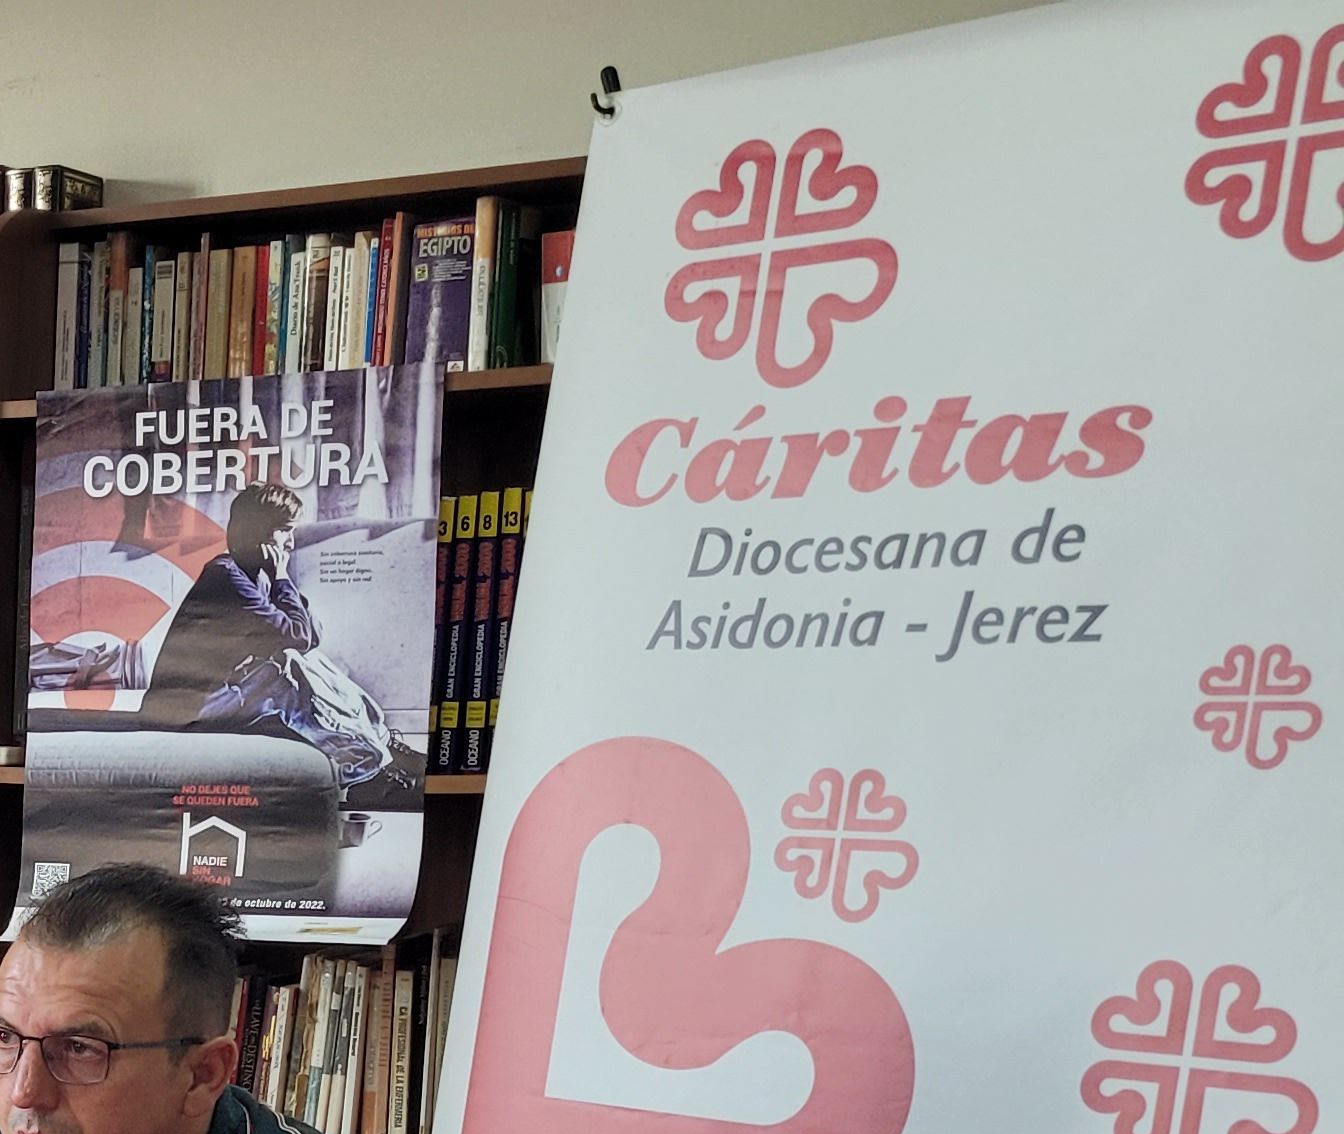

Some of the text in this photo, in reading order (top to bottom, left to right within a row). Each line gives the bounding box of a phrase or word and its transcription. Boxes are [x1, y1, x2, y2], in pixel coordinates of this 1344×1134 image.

[419, 235, 471, 258] EGIPTO
[135, 400, 334, 447] FUERA DE
[605, 395, 1153, 507] Cáritas
[83, 442, 389, 498] COBERTURA
[438, 520, 448, 536] 3
[461, 516, 470, 531] 6
[483, 515, 492, 531] 8
[504, 511, 518, 528] 13
[687, 508, 1087, 578] Diocesana de
[646, 597, 885, 651] Asidonia
[935, 590, 1109, 663] Jerez
[193, 856, 228, 867] NADIE
[244, 899, 281, 909] octubre
[284, 900, 297, 910] de
[298, 900, 326, 910] 2022.
